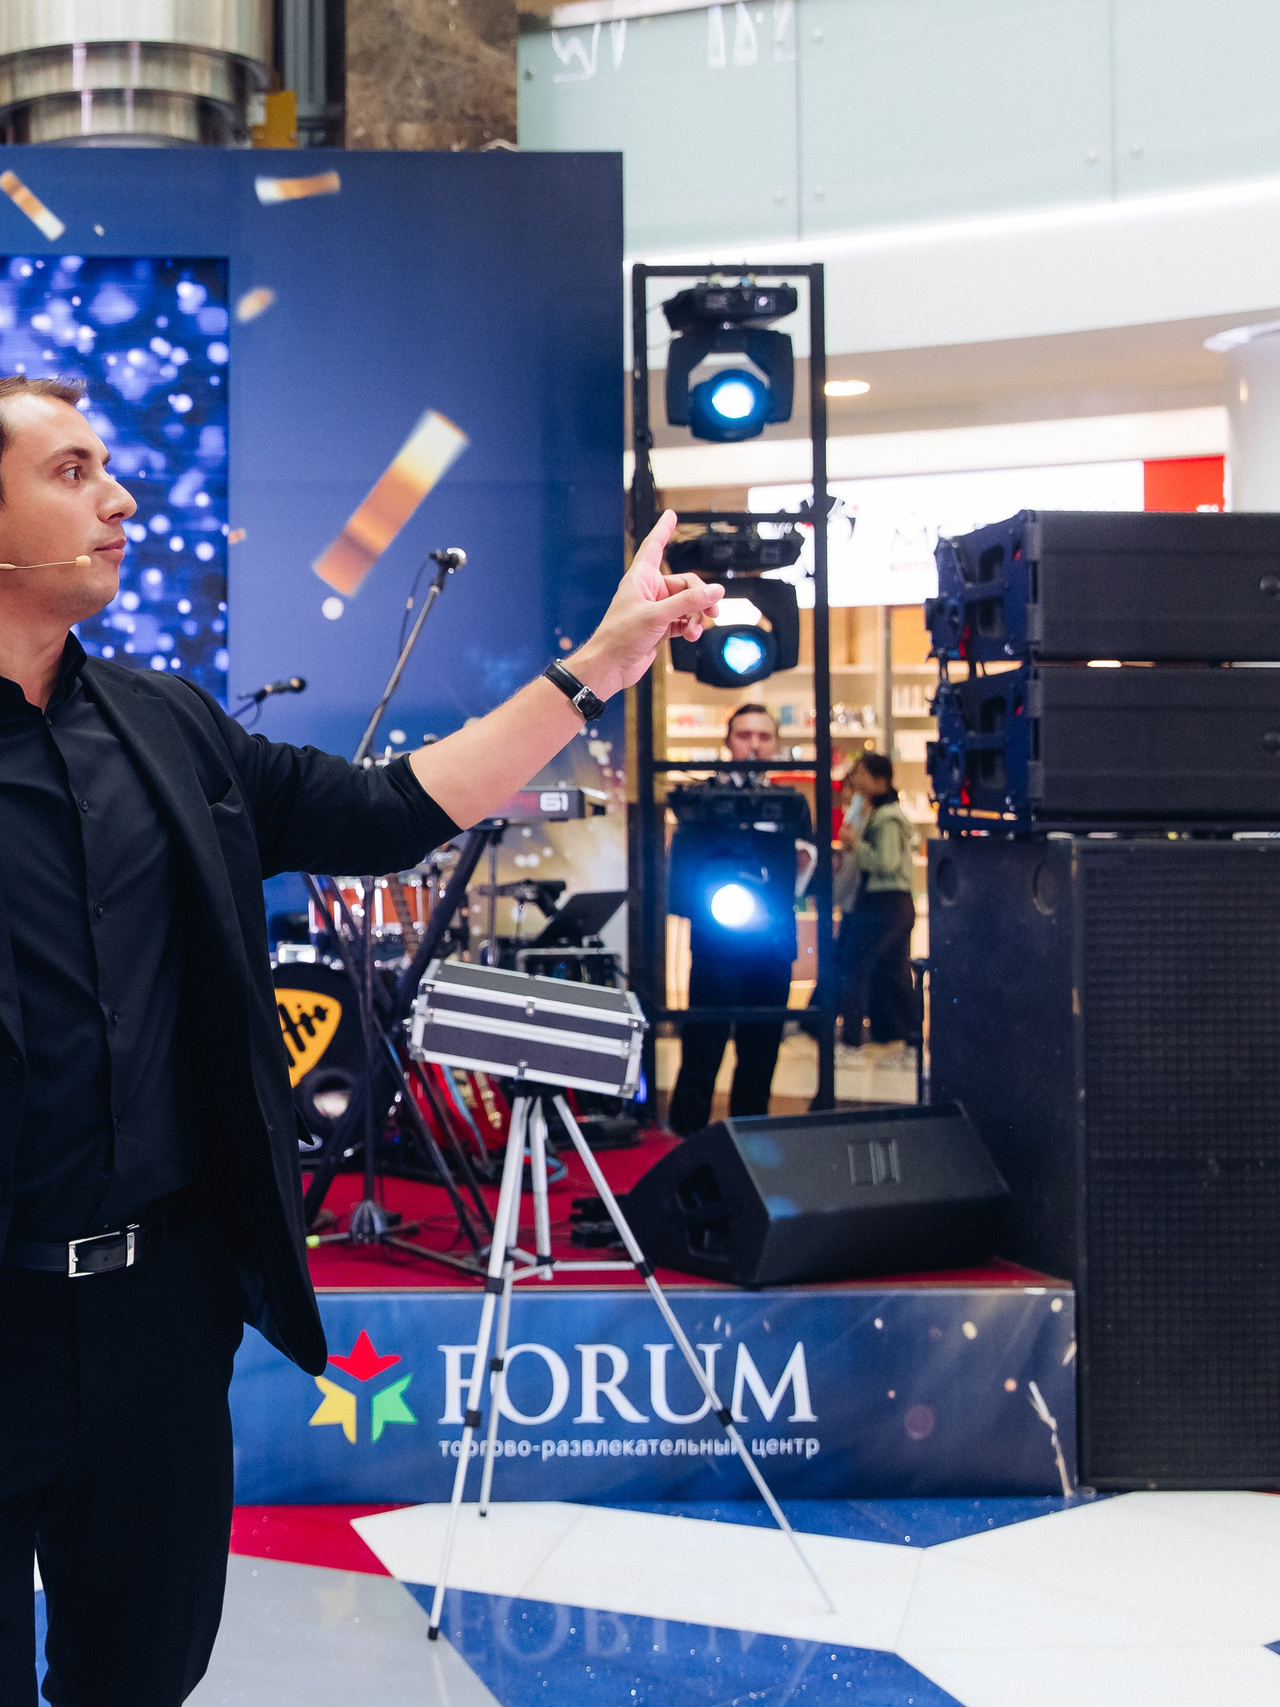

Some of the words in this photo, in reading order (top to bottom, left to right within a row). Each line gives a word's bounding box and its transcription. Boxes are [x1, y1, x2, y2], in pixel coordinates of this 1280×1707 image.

[540, 792, 568, 811] 61
[437, 1341, 819, 1425] FORUM
[751, 1437, 820, 1459] центр
